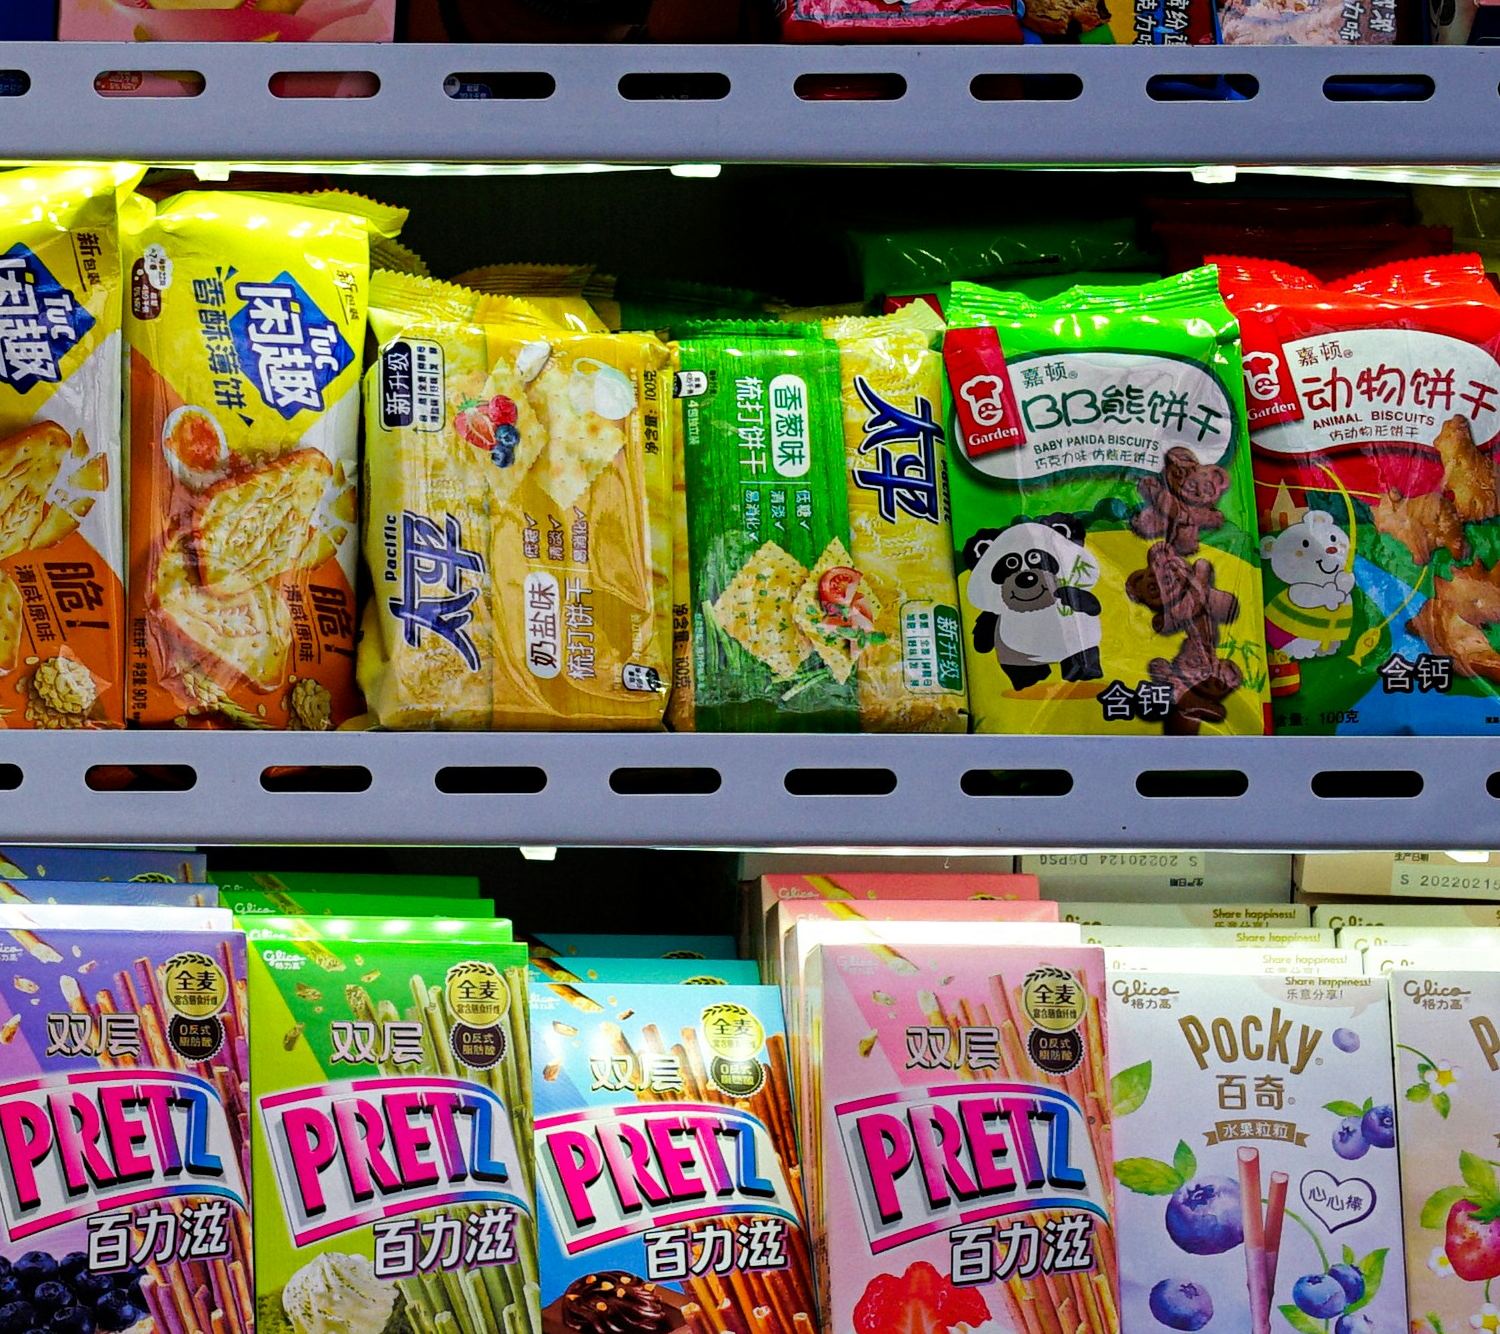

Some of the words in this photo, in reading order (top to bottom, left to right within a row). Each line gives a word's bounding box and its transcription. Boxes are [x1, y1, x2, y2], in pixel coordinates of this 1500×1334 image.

[1023, 384, 1222, 442] BB熊饼干
[1301, 365, 1498, 419] 动物饼干
[773, 385, 805, 465] 香葱味
[968, 425, 1018, 446] Garden
[1312, 413, 1363, 429] ANIMAL
[1371, 410, 1434, 427] BISCUITS
[1034, 440, 1064, 454] BABY
[1067, 437, 1104, 452] PANDA
[1108, 437, 1159, 451] BISCUITS
[392, 510, 483, 671] 太平
[527, 580, 557, 668] 奶盐味
[566, 577, 594, 681] 梳打饼干
[1102, 684, 1171, 717] 含钙
[46, 1012, 141, 1057] 双层
[1179, 1007, 1323, 1075] Pocky
[1217, 1076, 1285, 1111] 百奇
[1224, 1121, 1288, 1141] 水果粒粒
